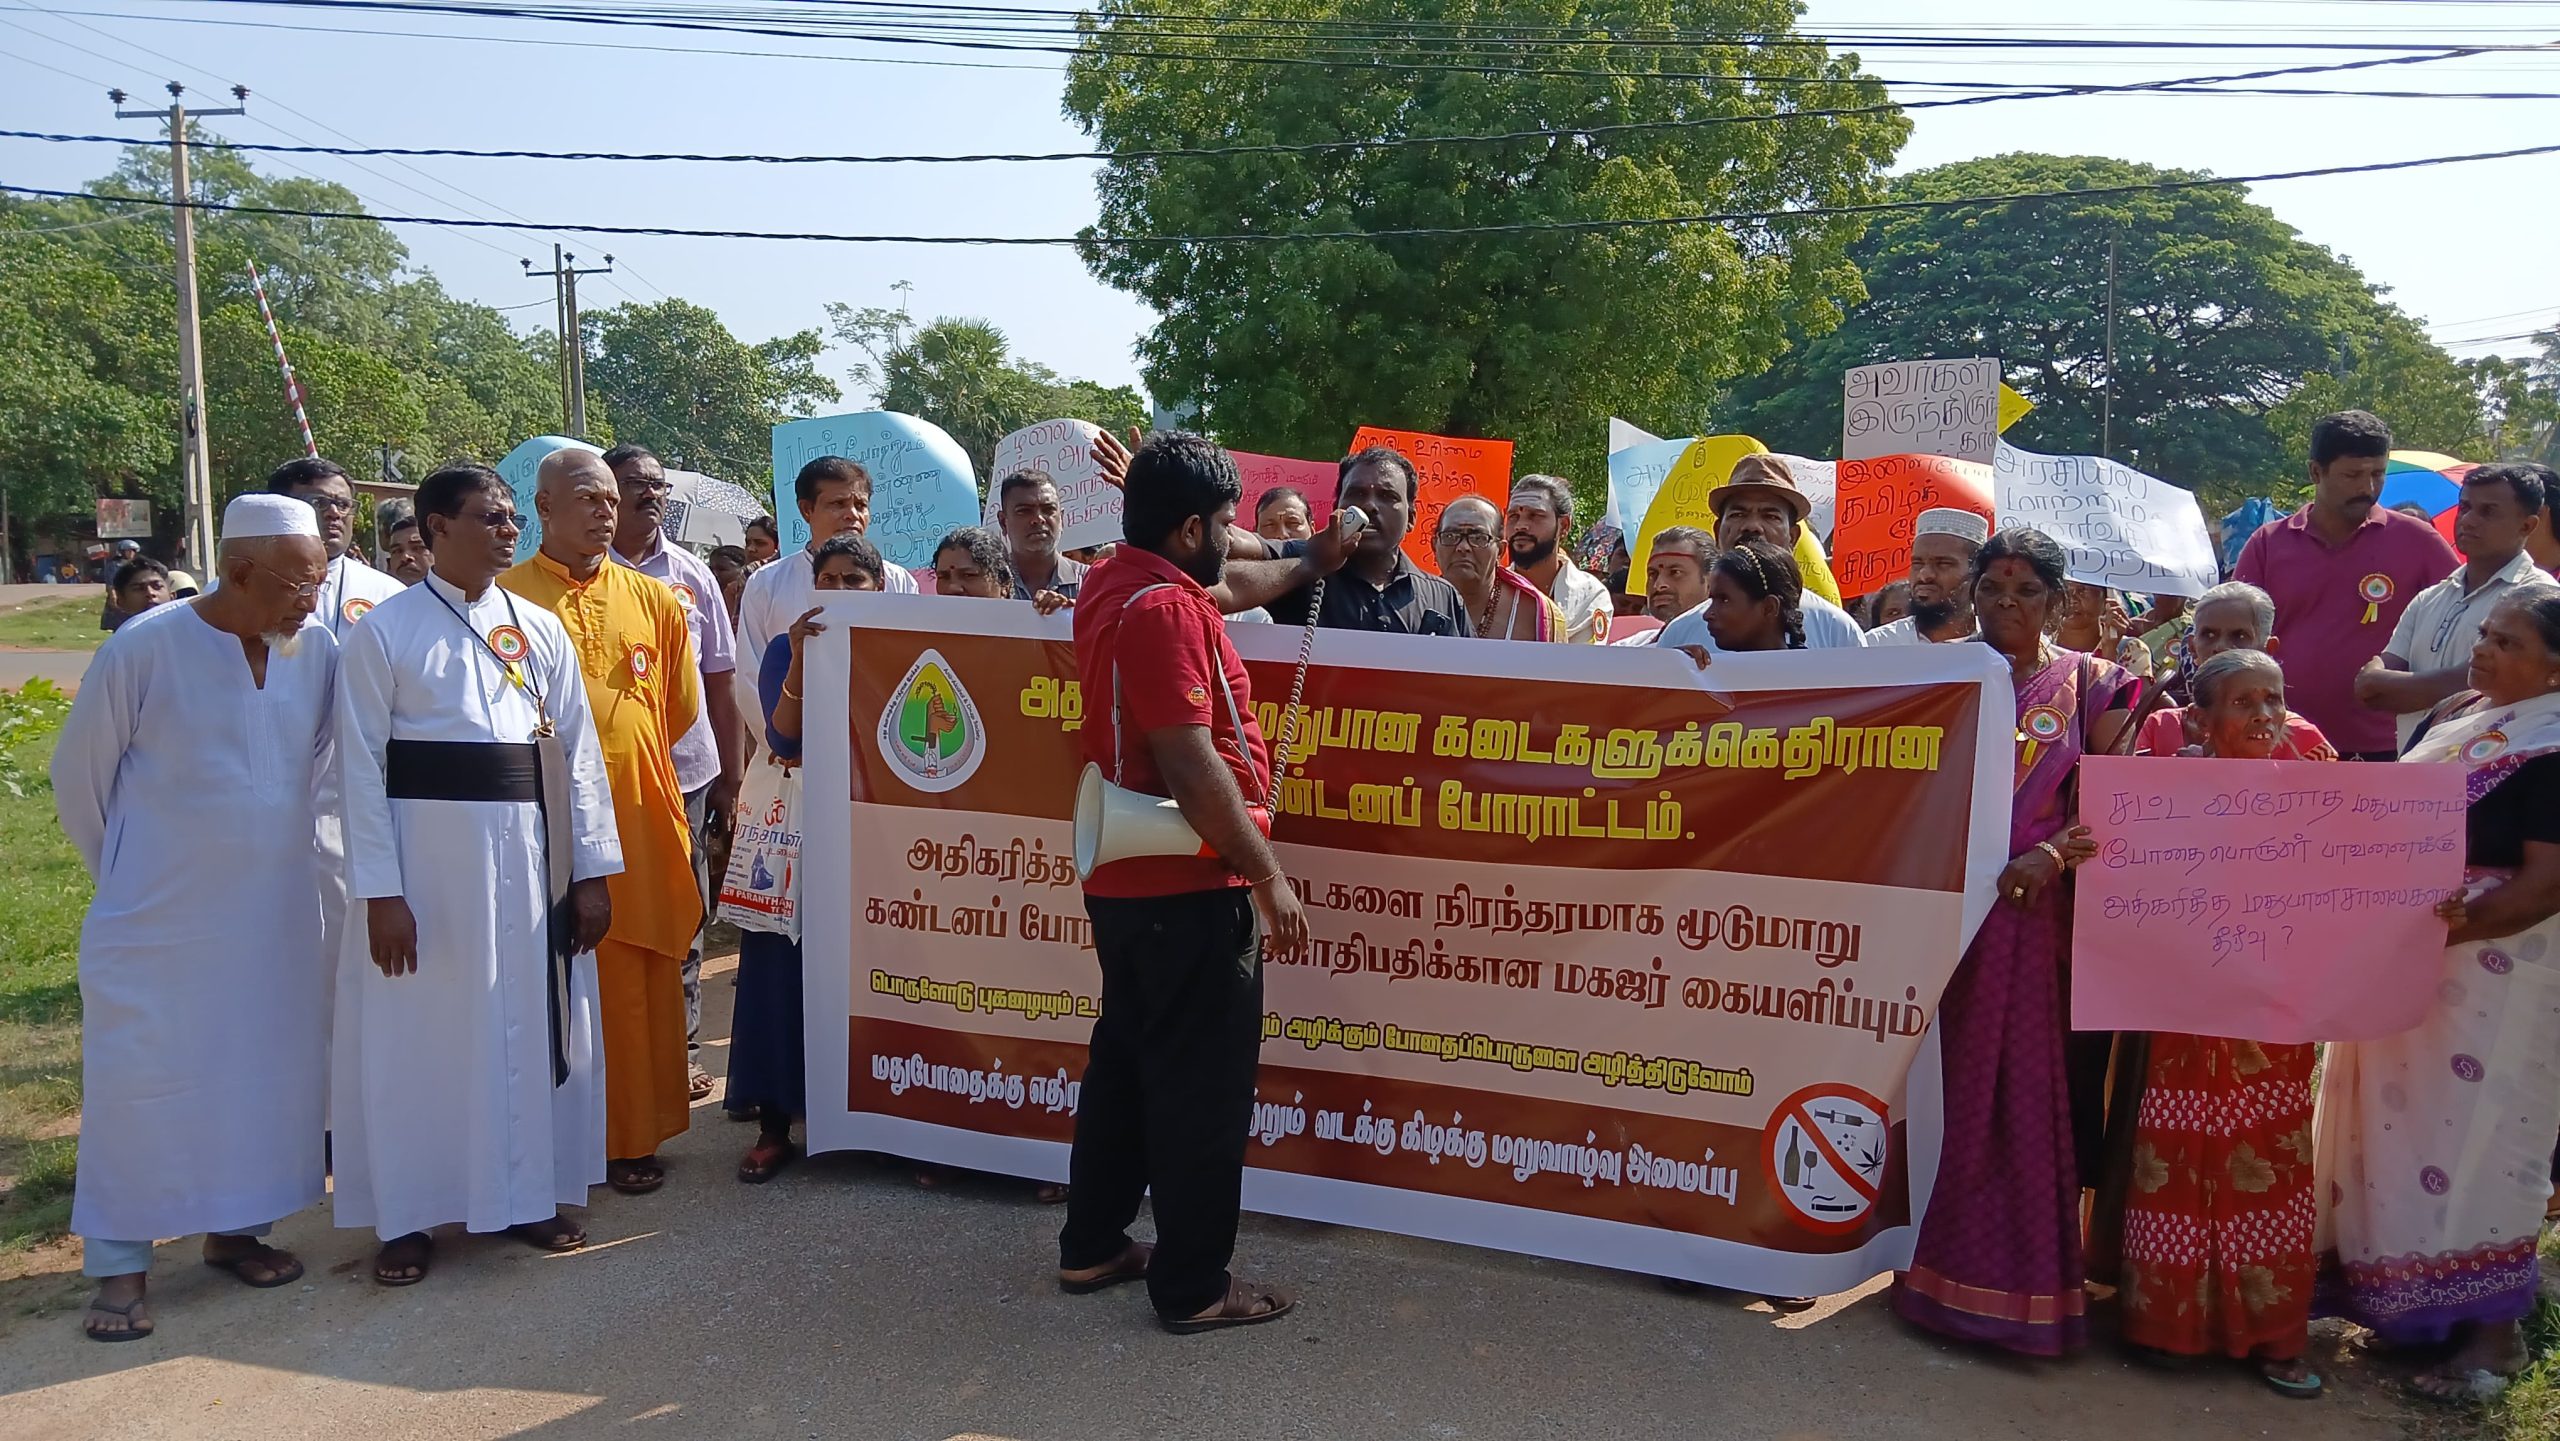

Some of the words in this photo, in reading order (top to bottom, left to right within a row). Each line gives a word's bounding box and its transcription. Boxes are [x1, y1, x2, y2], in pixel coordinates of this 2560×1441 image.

[1433, 715, 1943, 779] கடைகளுக்கெதிரான
[1270, 767, 1422, 827] ண்டனப்
[1438, 779, 1696, 843] போராட்டம்.
[2109, 792, 2191, 825] சட்ட
[2204, 789, 2343, 826] விரோத
[865, 888, 1007, 938] கண்டனப்
[1554, 956, 1671, 1009] மகஜர்
[1286, 875, 1424, 918] டைகளை
[1434, 883, 1664, 936] நிரந்தரமாக
[1677, 905, 1861, 967] மூடுமாறு
[871, 969, 976, 1013] பொருளோடு
[1286, 1013, 1381, 1050] அழிக்கும்
[1384, 1022, 1578, 1072] போதைப்பொருளை
[1582, 1050, 1754, 1097] அழித்திடுவோம்
[872, 1053, 1025, 1109] மதுபோதைக்கு
[1249, 1088, 1306, 1147] ற்றும்
[1315, 1099, 1396, 1155] வடக்கு
[1401, 1110, 1487, 1168] கிழக்கு
[1491, 1129, 1622, 1188] மறுவாழ்வு
[1627, 1143, 1738, 1206] அமைப்பு
